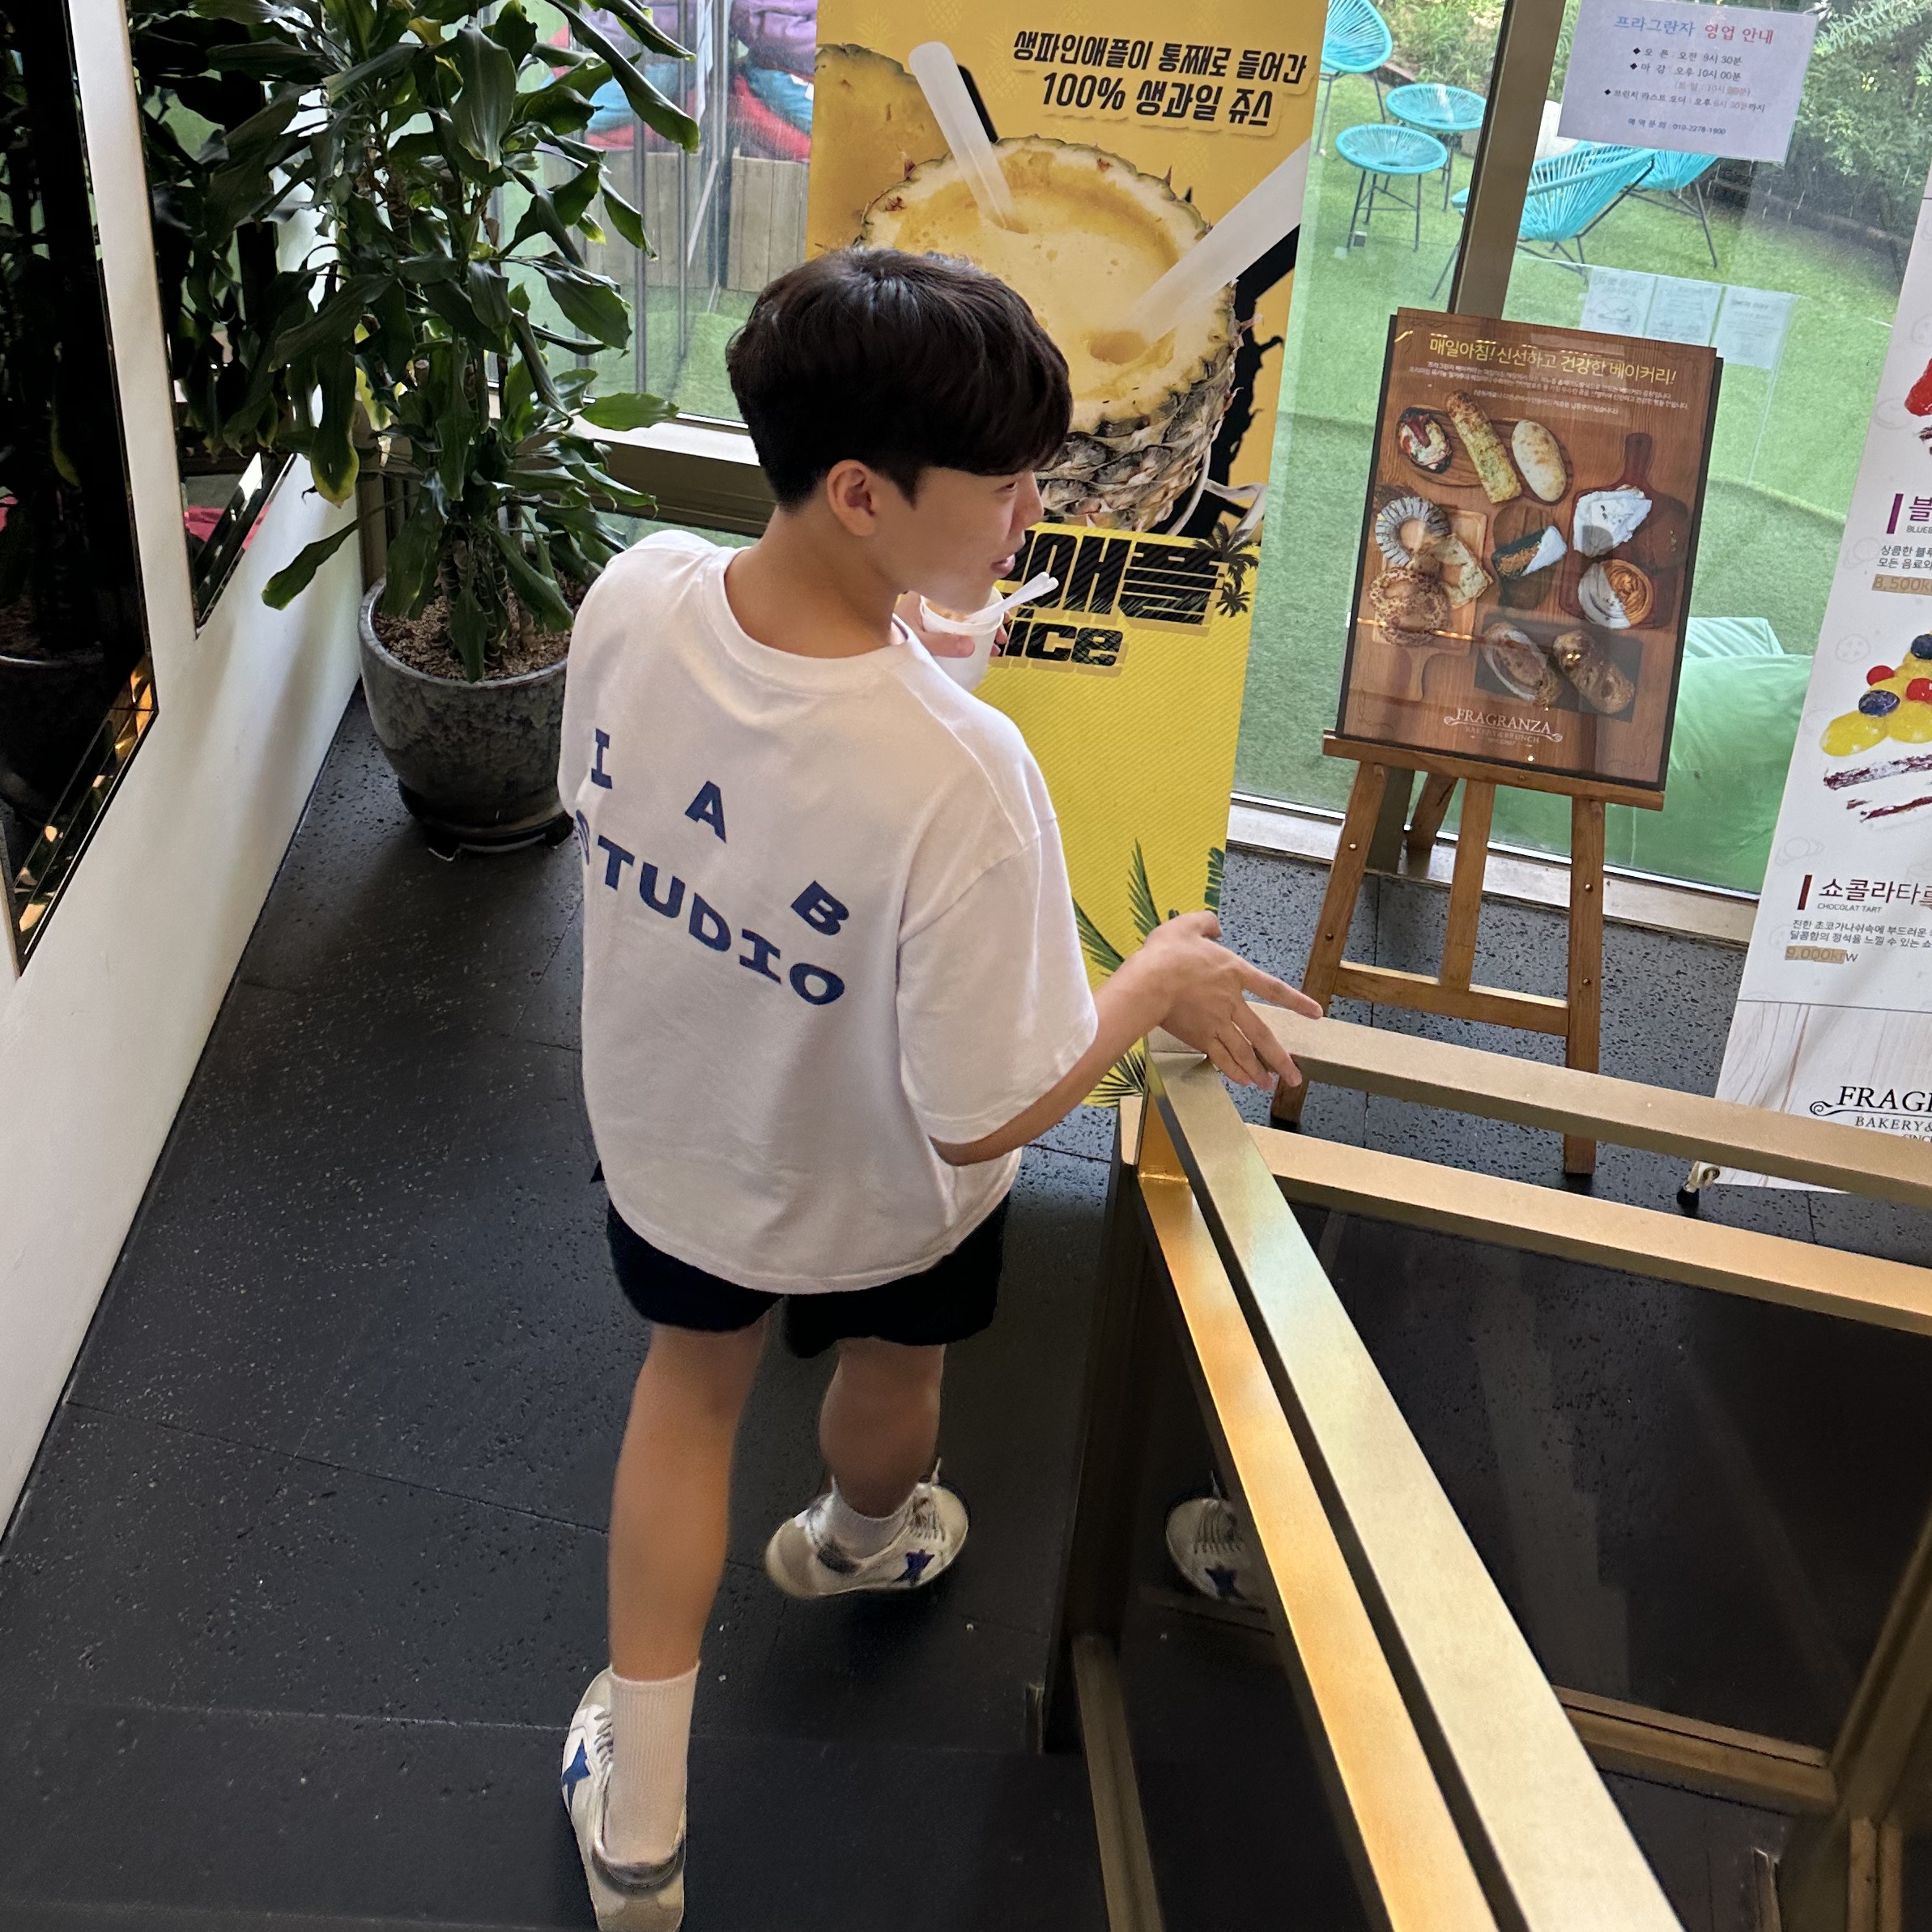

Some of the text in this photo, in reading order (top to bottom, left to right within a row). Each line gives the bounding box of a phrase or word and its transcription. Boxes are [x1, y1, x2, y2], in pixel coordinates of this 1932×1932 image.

[1613, 16, 1774, 45] 프라그란자 영업 안내
[1014, 31, 1308, 84] 생파인애플이 통째로 들어간
[1697, 68, 1717, 80] 10시
[1043, 72, 1273, 126] 100% 생과일 쥬스
[1430, 338, 1677, 385] 매일아침! 신선하고 건강한 베이커리!
[1881, 545, 1913, 556] 상큼한
[1878, 557, 1899, 568] 모든
[1457, 709, 1551, 734] FRAGRANZA
[1817, 903, 1883, 913] CHOCOLAT TART
[1793, 920, 1812, 930] 진한
[1888, 926, 1927, 938] 부드러운
[1832, 933, 1862, 944] 정석을
[1864, 936, 1884, 947] 느낄
[1887, 937, 1897, 946] 수
[1900, 938, 1920, 948] 있는
